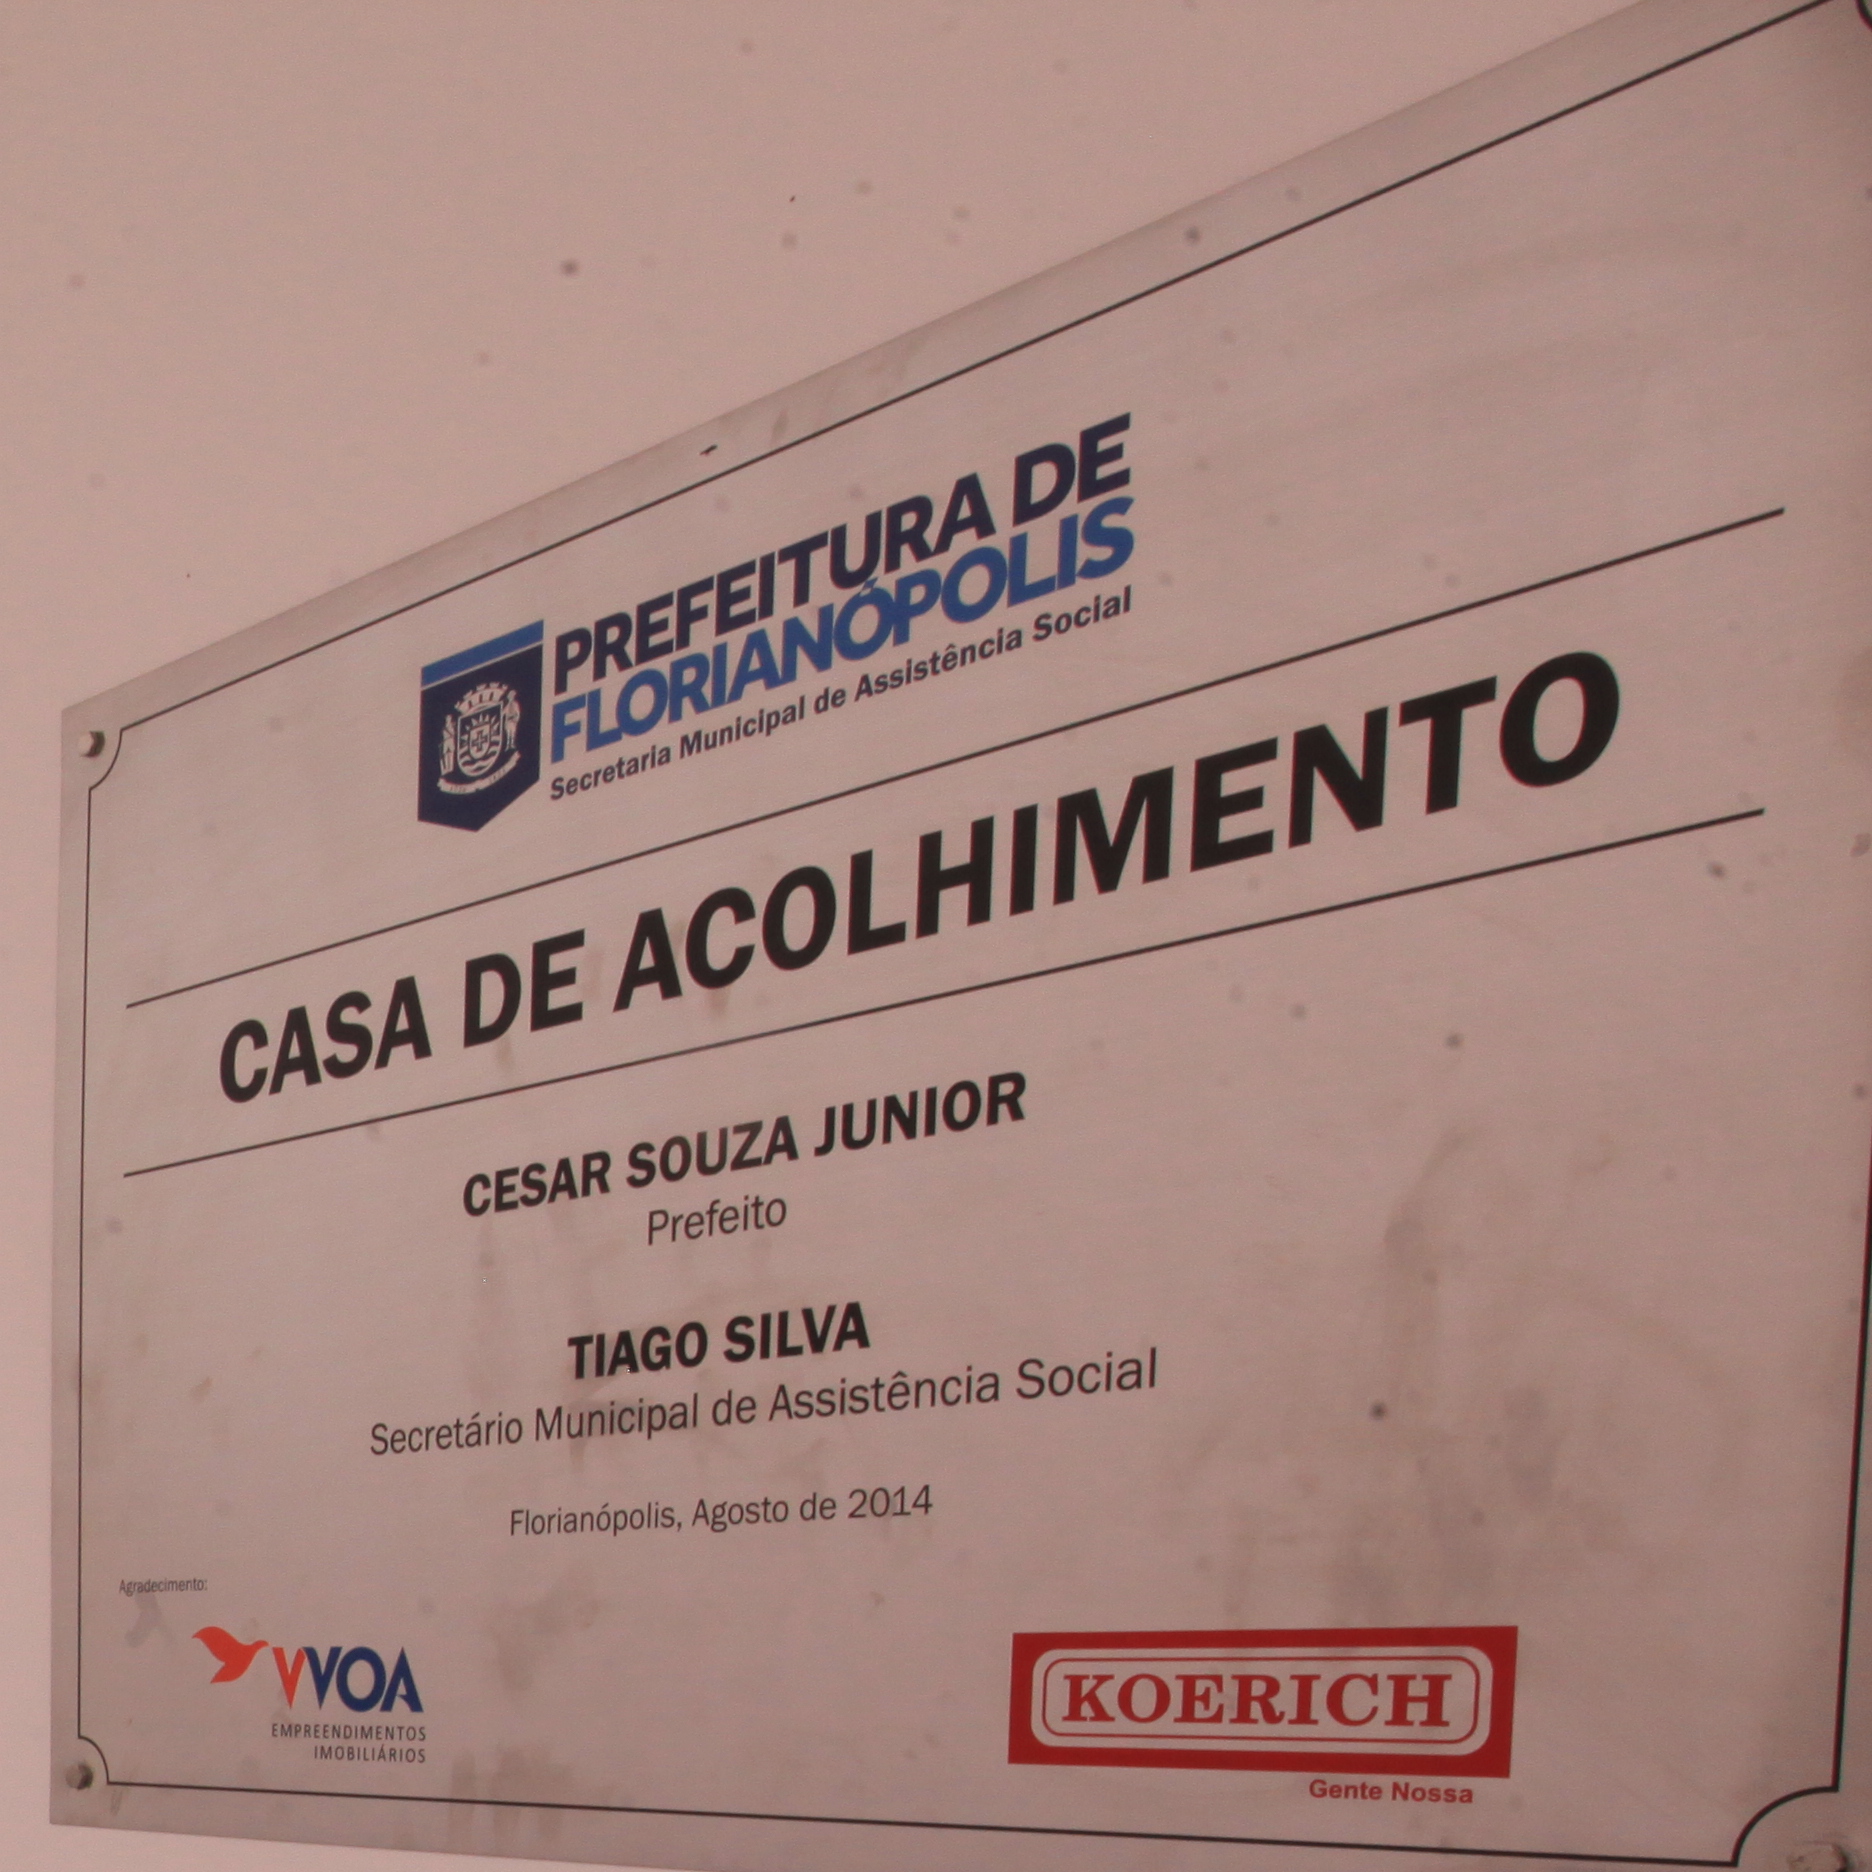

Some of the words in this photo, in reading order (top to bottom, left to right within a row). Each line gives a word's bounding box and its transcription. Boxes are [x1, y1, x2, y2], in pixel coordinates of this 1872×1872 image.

[554, 472, 997, 696] PREFEITURA
[1012, 412, 1131, 528] DE
[551, 496, 1134, 764] FLORIANÓPOLIS
[550, 744, 671, 801] Secretaria
[679, 695, 805, 760] Municipal
[813, 687, 846, 715] de
[854, 627, 1023, 702] Assistência
[1032, 584, 1131, 642] Social
[219, 975, 432, 1104] CASA
[463, 928, 585, 1049] DE
[613, 651, 1620, 1013] ACOLHIMENTO
[463, 1150, 611, 1217] CESAR
[626, 1115, 799, 1189] SOUZA
[814, 1071, 1026, 1157] JUNIOR
[648, 1194, 787, 1246] Prefeito
[567, 1321, 708, 1380] TIAGO
[723, 1301, 871, 1363] SILVA
[370, 1411, 523, 1456] Secretário
[535, 1392, 698, 1442] Municipal
[711, 1391, 757, 1427] de
[768, 1364, 1000, 1422] Assistência
[1016, 1346, 1157, 1400] Social
[510, 1501, 682, 1537] Florianópolis,
[691, 1496, 789, 1533] Agosto
[799, 1492, 837, 1522] de
[847, 1484, 933, 1519] 2014
[271, 1722, 426, 1742] EMPREENDIMENTOS
[1062, 1673, 1453, 1728] KOERICH
[314, 1743, 426, 1764] IMOBILIÁRIOS
[1308, 1778, 1383, 1801] Gente
[1391, 1781, 1474, 1804] Nossa
